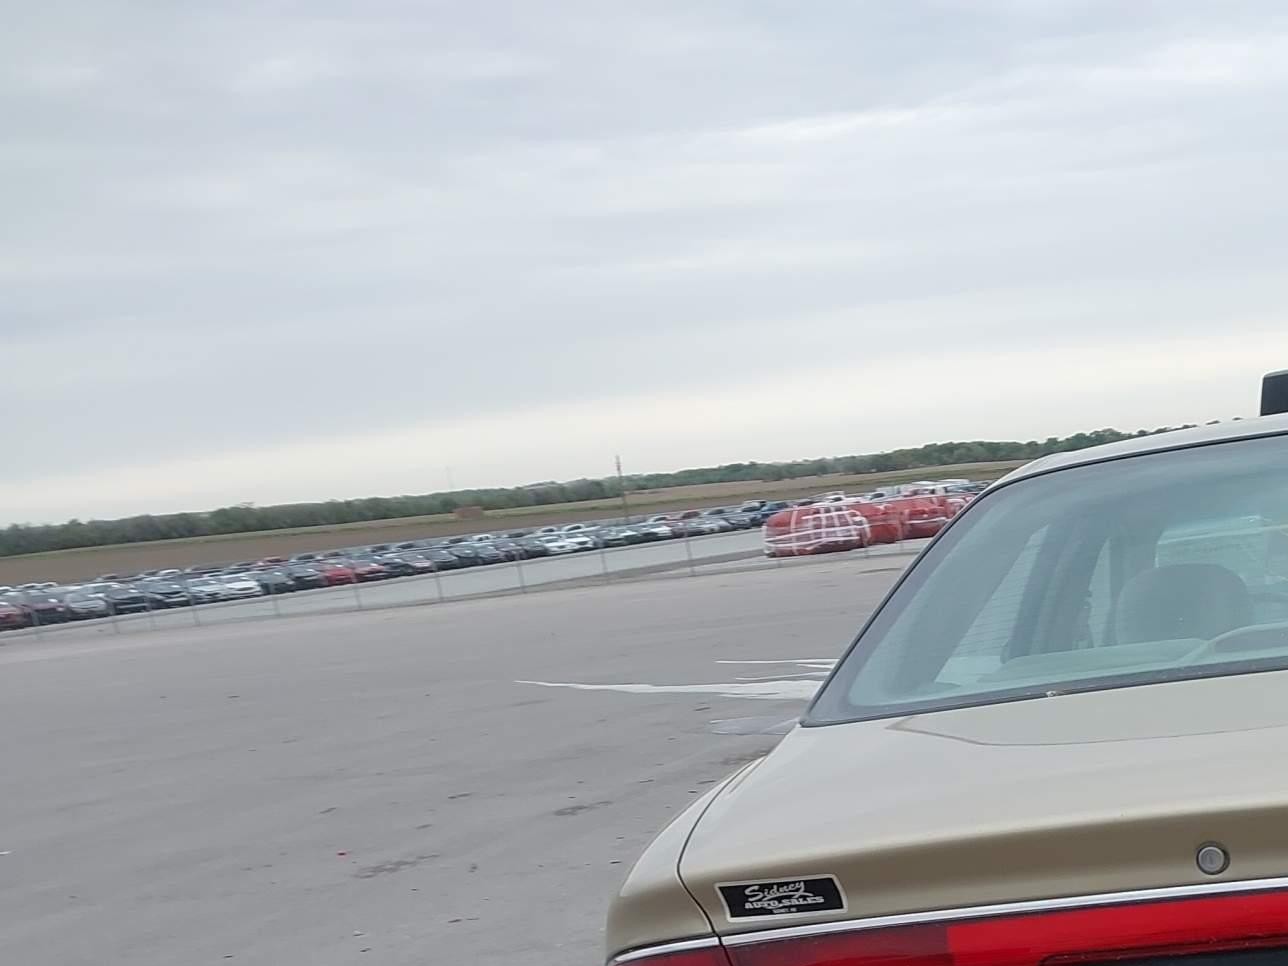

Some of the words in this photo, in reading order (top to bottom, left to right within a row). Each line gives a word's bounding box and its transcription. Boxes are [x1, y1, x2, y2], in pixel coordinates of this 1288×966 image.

[744, 881, 807, 901] Sidney
[744, 900, 779, 909] AUTO
[781, 896, 825, 906] SALES
